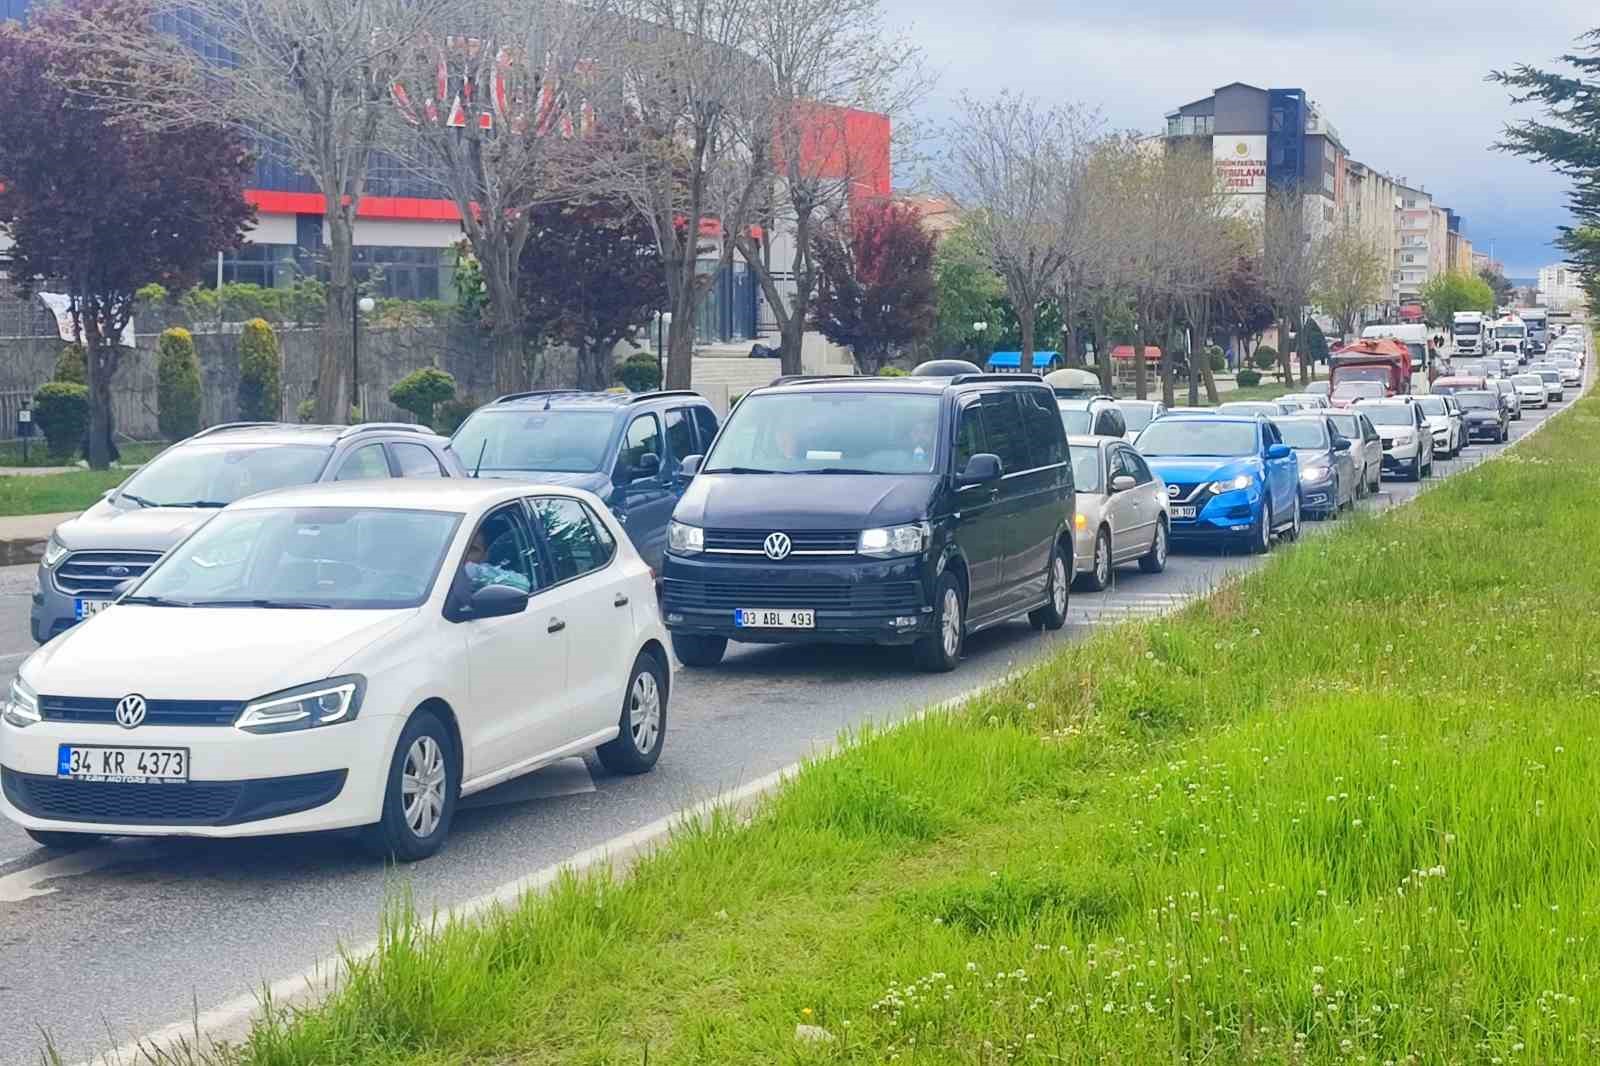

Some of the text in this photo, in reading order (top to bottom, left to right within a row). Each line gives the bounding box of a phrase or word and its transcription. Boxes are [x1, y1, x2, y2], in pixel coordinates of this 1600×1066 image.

[83, 601, 96, 615] 34
[743, 612, 812, 626] 03 ABL 493
[70, 750, 184, 776] 34 KR 4373
